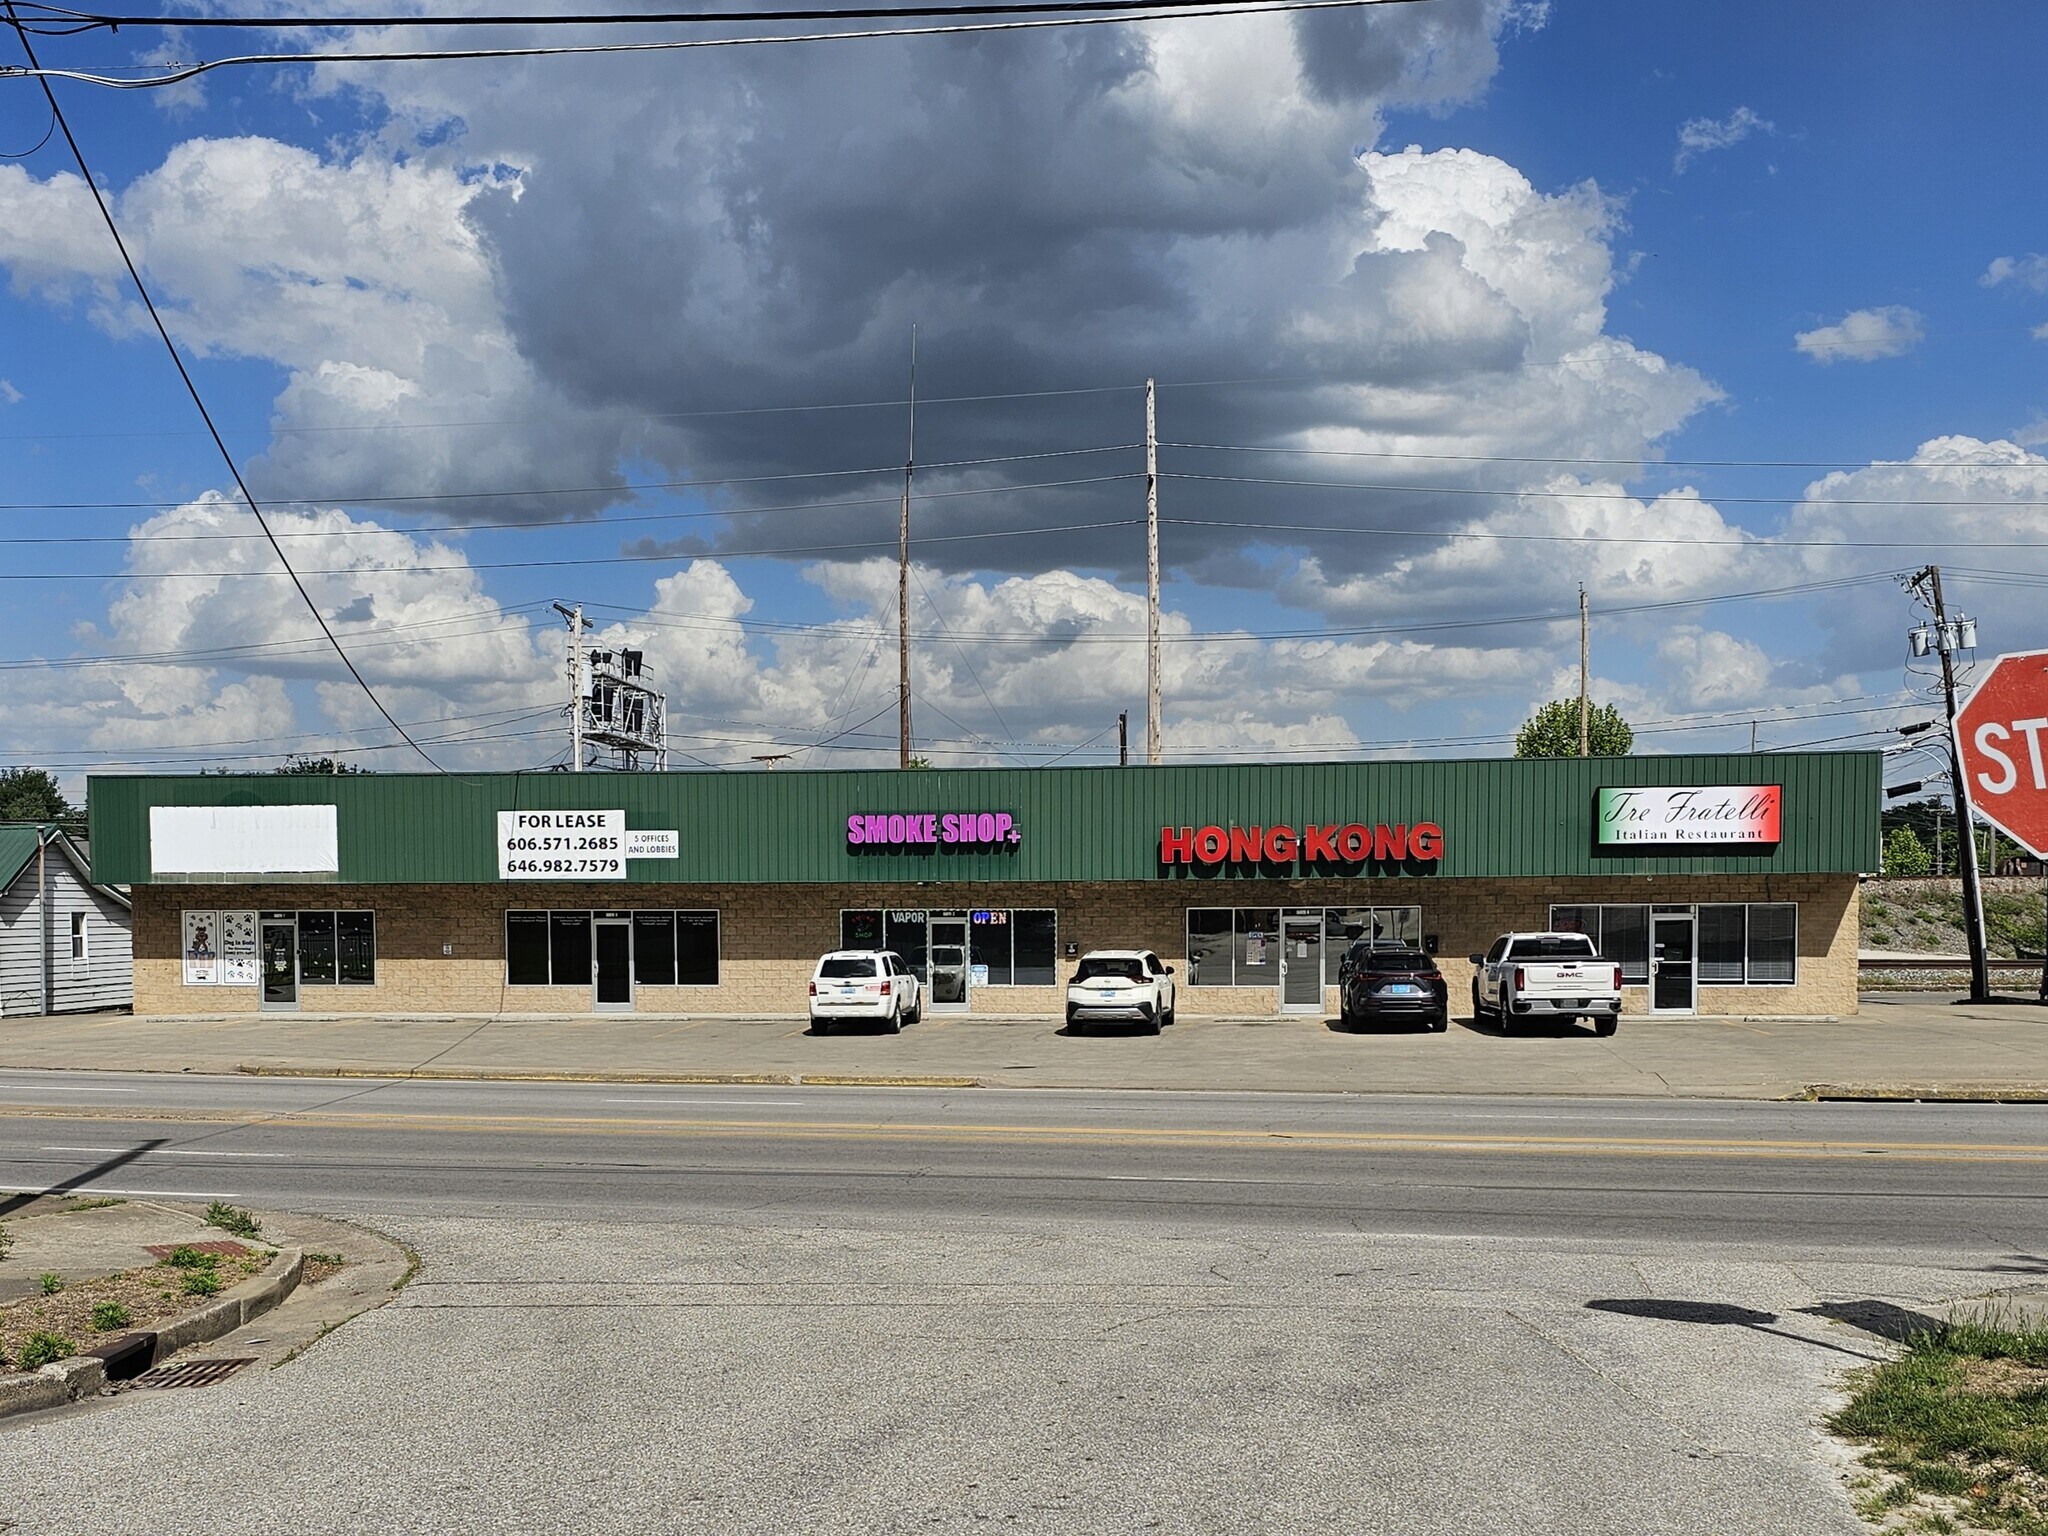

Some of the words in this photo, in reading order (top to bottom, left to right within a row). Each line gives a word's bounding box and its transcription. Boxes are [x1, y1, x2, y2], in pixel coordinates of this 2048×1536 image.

[1974, 717, 2048, 795] ST
[1604, 792, 1651, 823] Tre
[1664, 790, 1775, 824] Fratelli
[518, 815, 551, 828] FOR
[555, 814, 606, 828] LEASE
[848, 814, 937, 844] SMOKE
[1616, 829, 1667, 840] Italian
[1676, 828, 1763, 840] Restaurant
[507, 837, 618, 851] 606.571.2685
[634, 835, 639, 843] 5
[641, 834, 670, 843] OFFICES
[1161, 825, 1298, 863] HONG
[1305, 822, 1444, 862] KONG
[646, 845, 676, 853] LOBBIES
[507, 859, 619, 873] 646.982.7579
[892, 912, 925, 923] VAPOR
[973, 912, 1007, 924] OPEN
